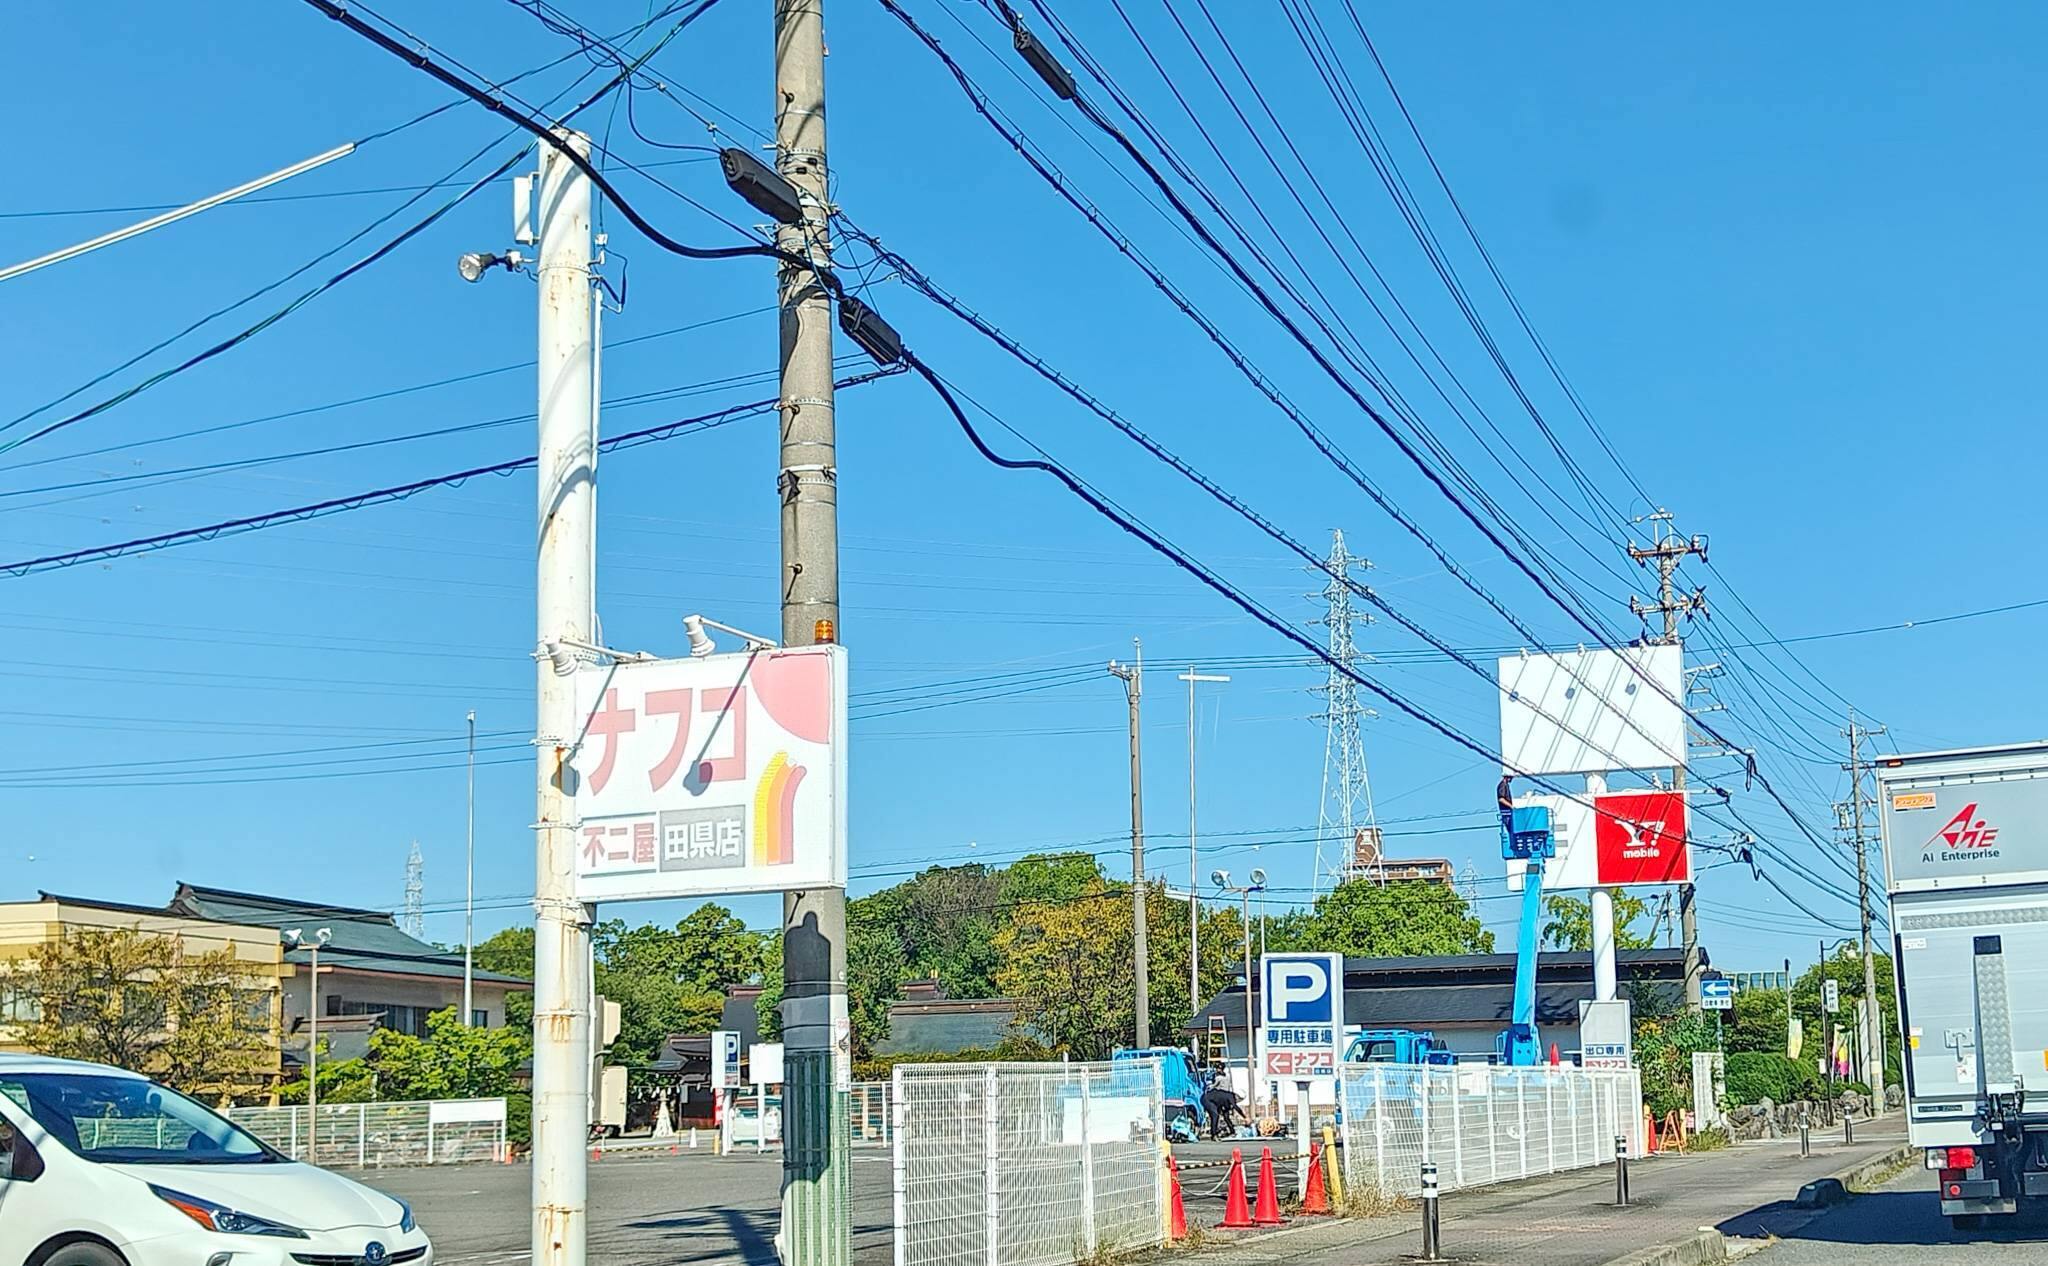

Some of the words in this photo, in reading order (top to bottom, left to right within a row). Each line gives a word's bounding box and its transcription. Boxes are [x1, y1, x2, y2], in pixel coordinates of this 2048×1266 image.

[586, 686, 747, 796] ナフコ
[583, 823, 655, 868] 不二屋
[664, 818, 742, 861] 田県店
[1623, 847, 1660, 859] mobile
[1941, 849, 2000, 861] Enterprise
[1270, 962, 1328, 1020] P
[1267, 1029, 1332, 1044] 専用駐車場
[1585, 1046, 1625, 1056] 出口専用
[1294, 1052, 1333, 1067] ナフコ
